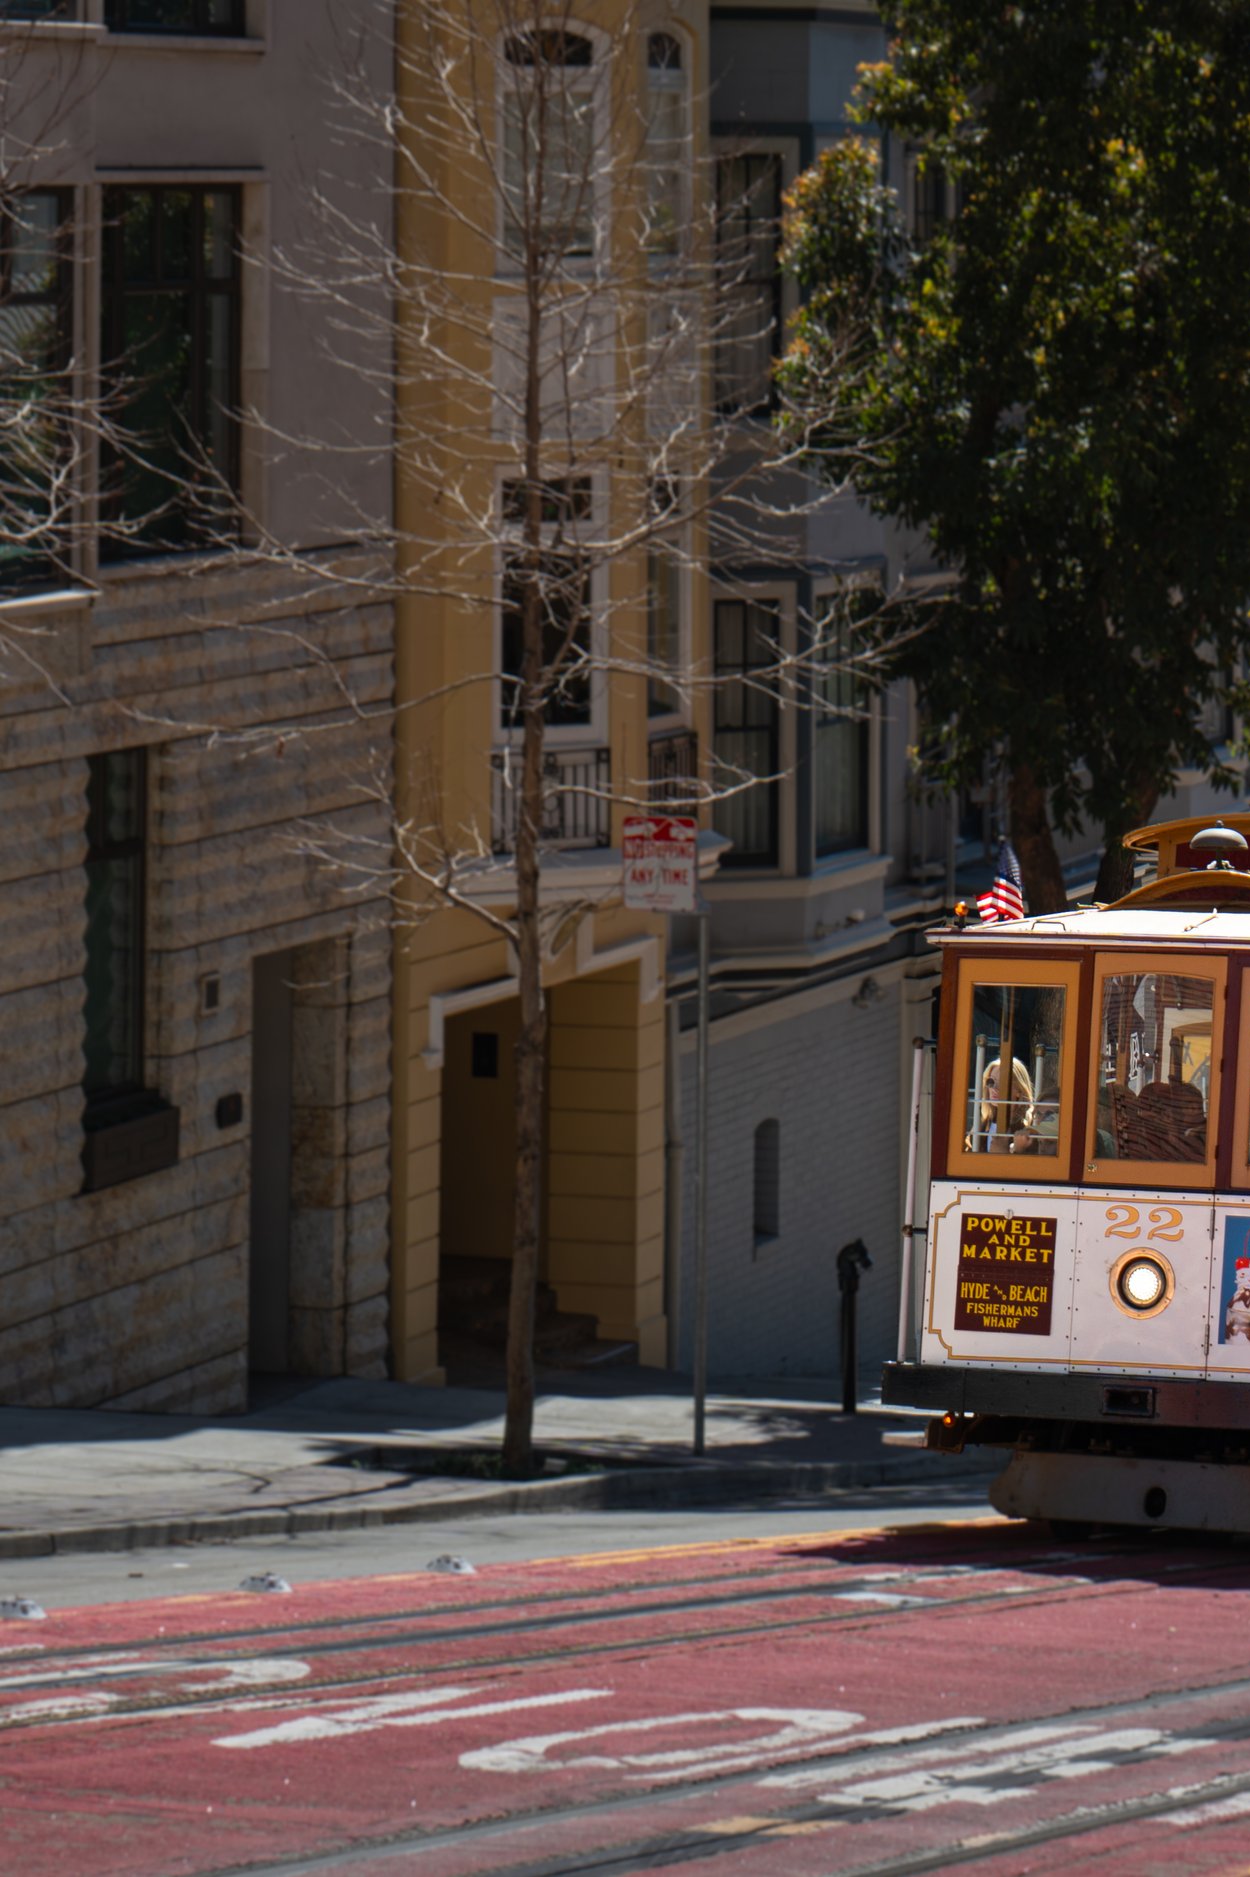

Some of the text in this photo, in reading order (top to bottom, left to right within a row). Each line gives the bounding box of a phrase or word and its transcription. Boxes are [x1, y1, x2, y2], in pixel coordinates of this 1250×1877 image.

[631, 868, 688, 885] ANY TIME
[966, 1217, 1053, 1236] POWELL
[1104, 1204, 1185, 1242] 22
[988, 1233, 1031, 1246] AND
[962, 1244, 1053, 1263] MARKET
[960, 1282, 1048, 1303] HYDE AND BEACH
[966, 1302, 1039, 1317] FISHERMANS
[983, 1316, 1021, 1328] WHARF
